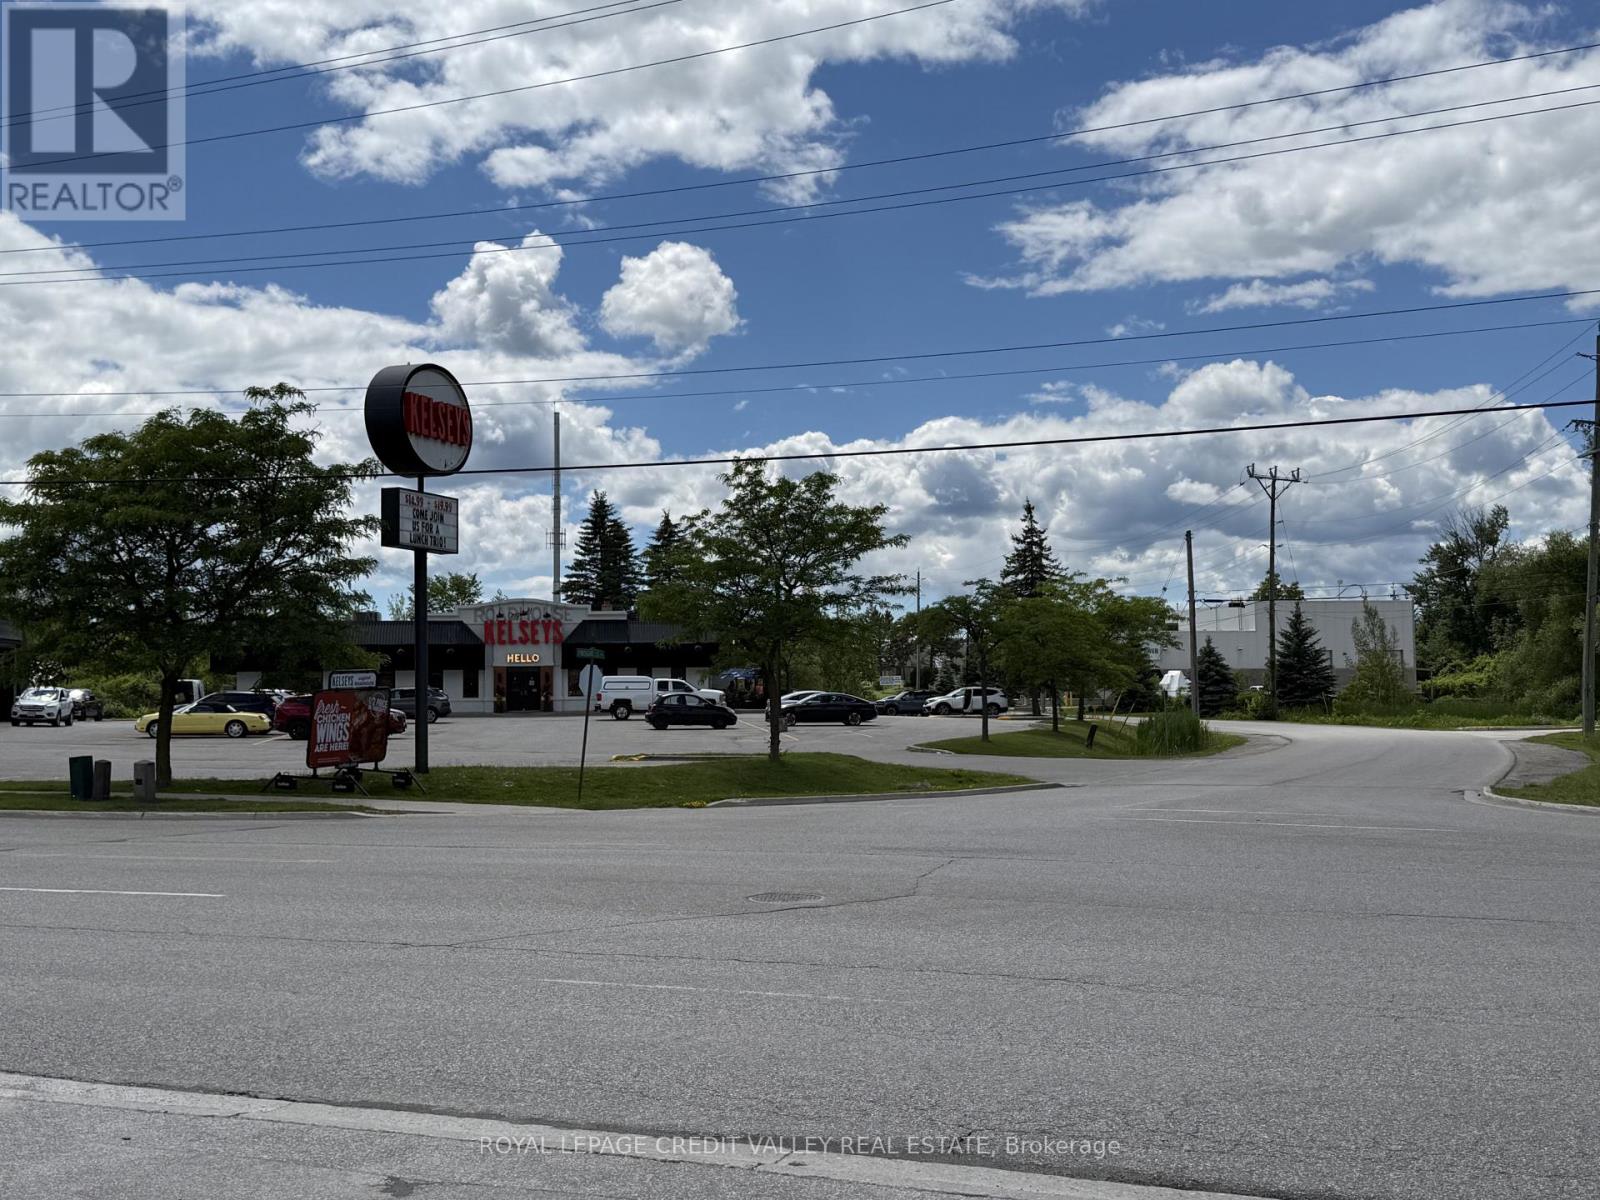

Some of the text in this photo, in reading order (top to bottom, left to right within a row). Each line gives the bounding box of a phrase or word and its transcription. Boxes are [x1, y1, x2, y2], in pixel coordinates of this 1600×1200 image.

[405, 391, 469, 448] KELSEYS
[412, 507, 445, 524] COME JOIN
[412, 520, 440, 535] US FOR A
[409, 532, 429, 546] LUNCH
[484, 619, 564, 645] KELSEYS
[506, 653, 540, 663] HELLO
[316, 712, 351, 723] CHICKEN
[316, 722, 350, 743] WINGS
[314, 743, 329, 753] ARE
